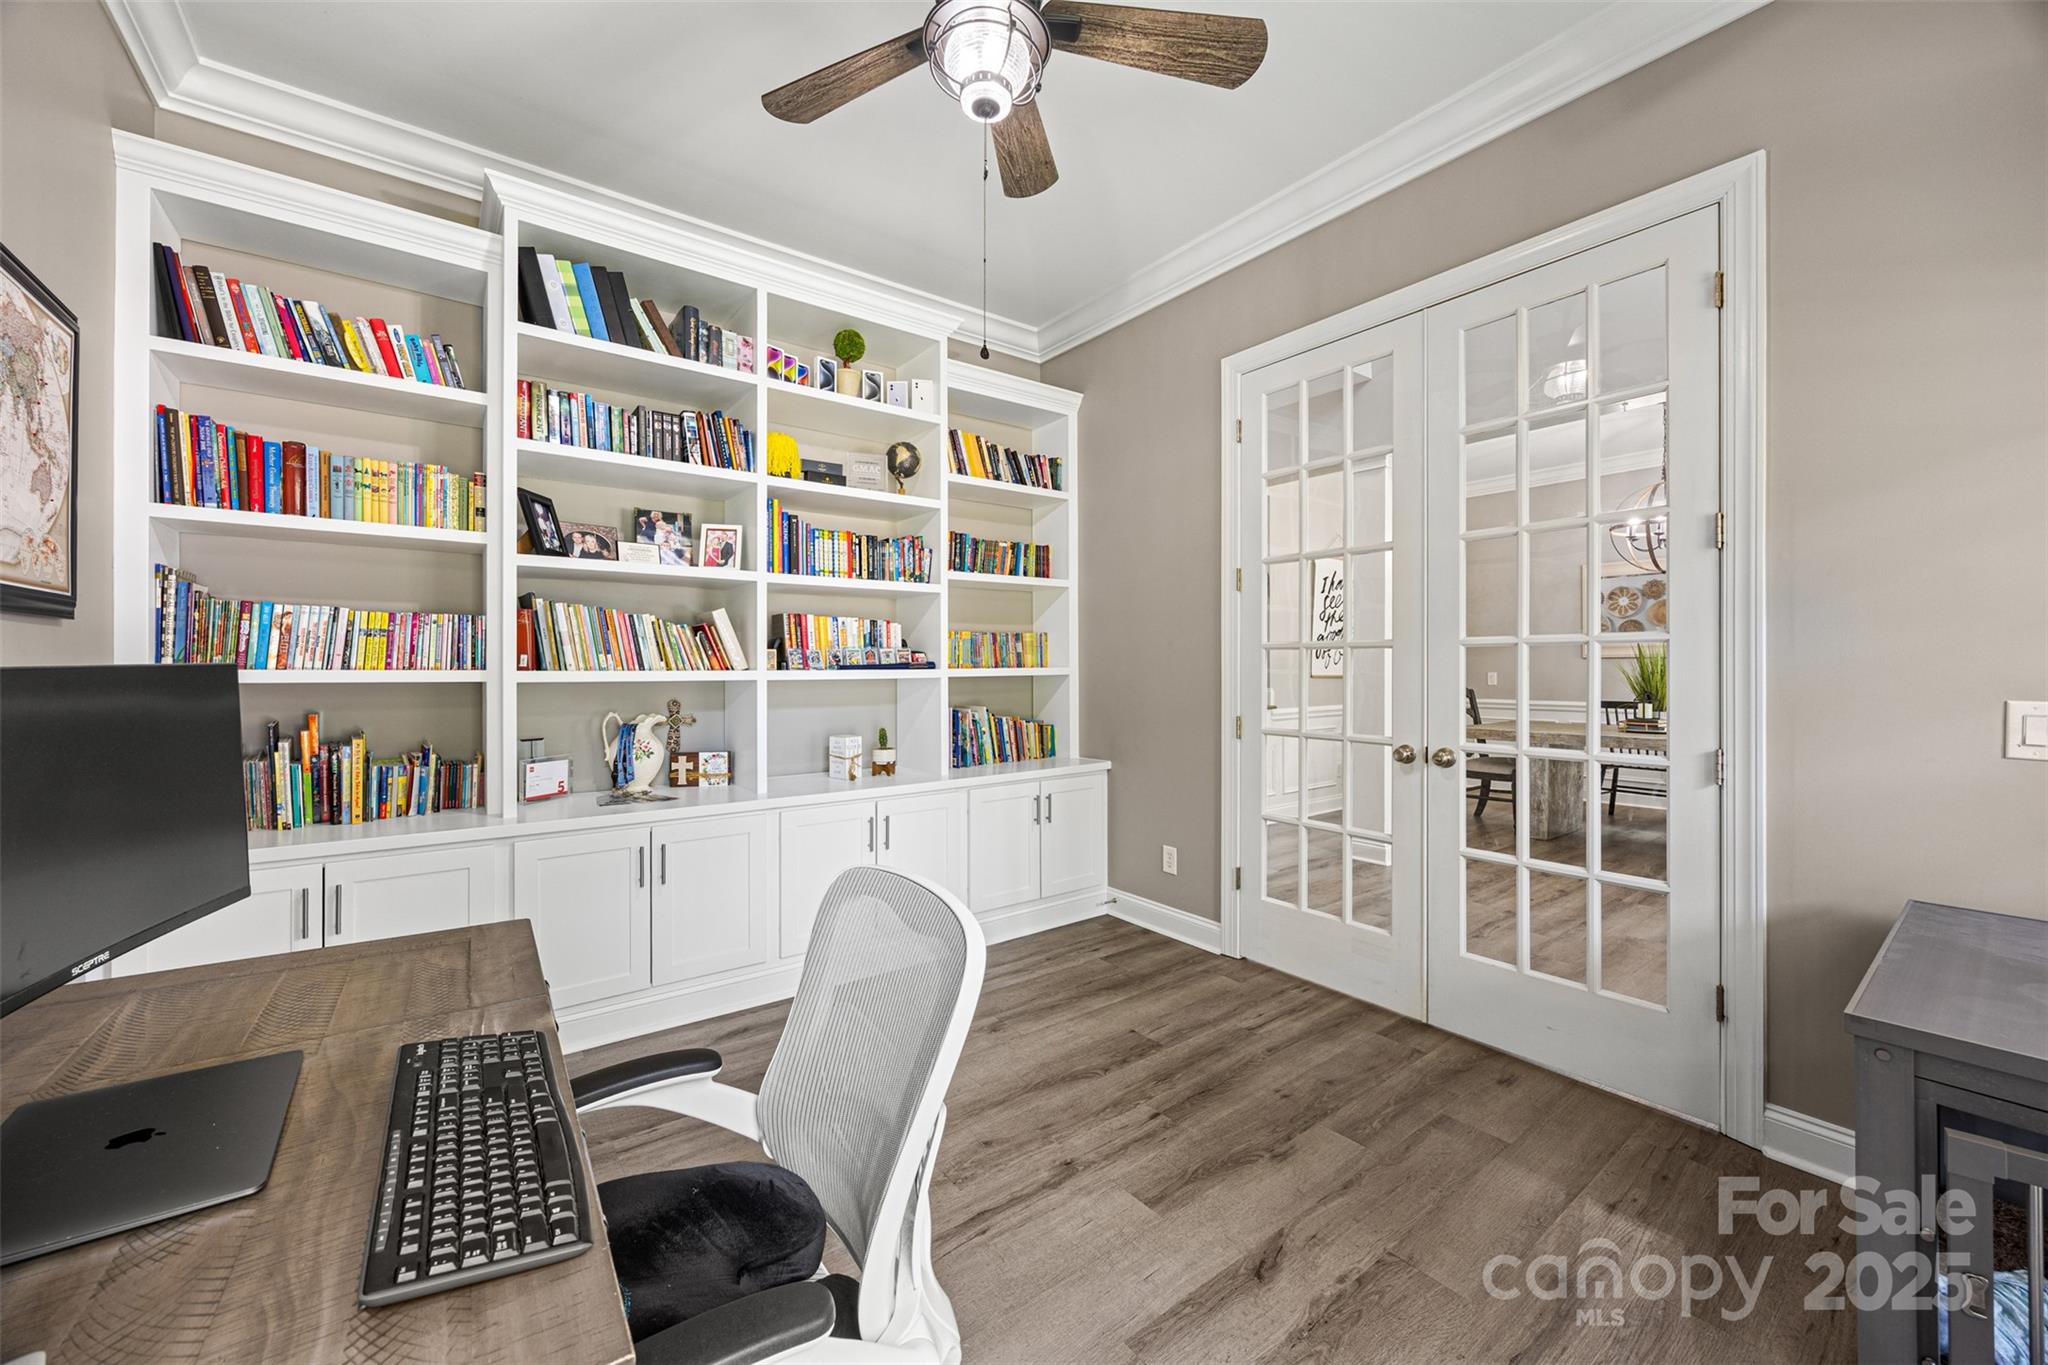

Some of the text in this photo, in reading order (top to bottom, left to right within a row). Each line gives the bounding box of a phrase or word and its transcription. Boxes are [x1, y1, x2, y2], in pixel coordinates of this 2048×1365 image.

[268, 446, 276, 465] Mother
[558, 780, 565, 793] 5
[71, 950, 110, 977] SCEPTRE
